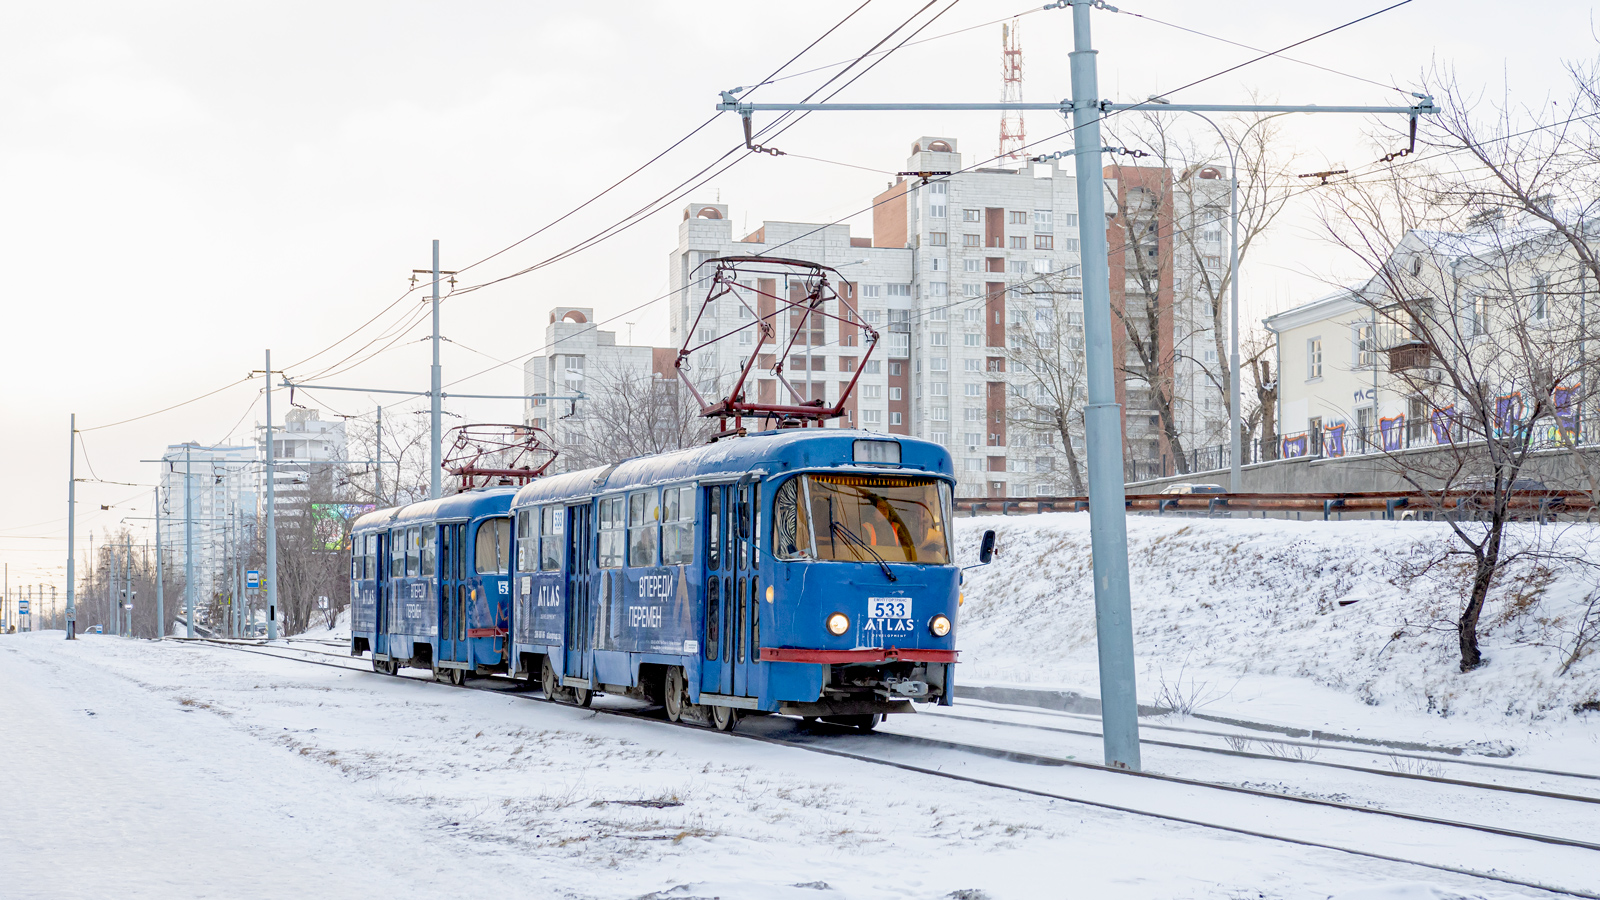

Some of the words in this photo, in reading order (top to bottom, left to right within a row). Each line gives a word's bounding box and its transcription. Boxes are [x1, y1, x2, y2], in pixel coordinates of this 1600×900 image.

[537, 585, 560, 607] ATLAS
[639, 574, 673, 602] ВПЕРЕДИ
[629, 606, 662, 628] ПЕРЕМЕН
[875, 603, 905, 618] 533
[864, 618, 914, 631] ATLAS
